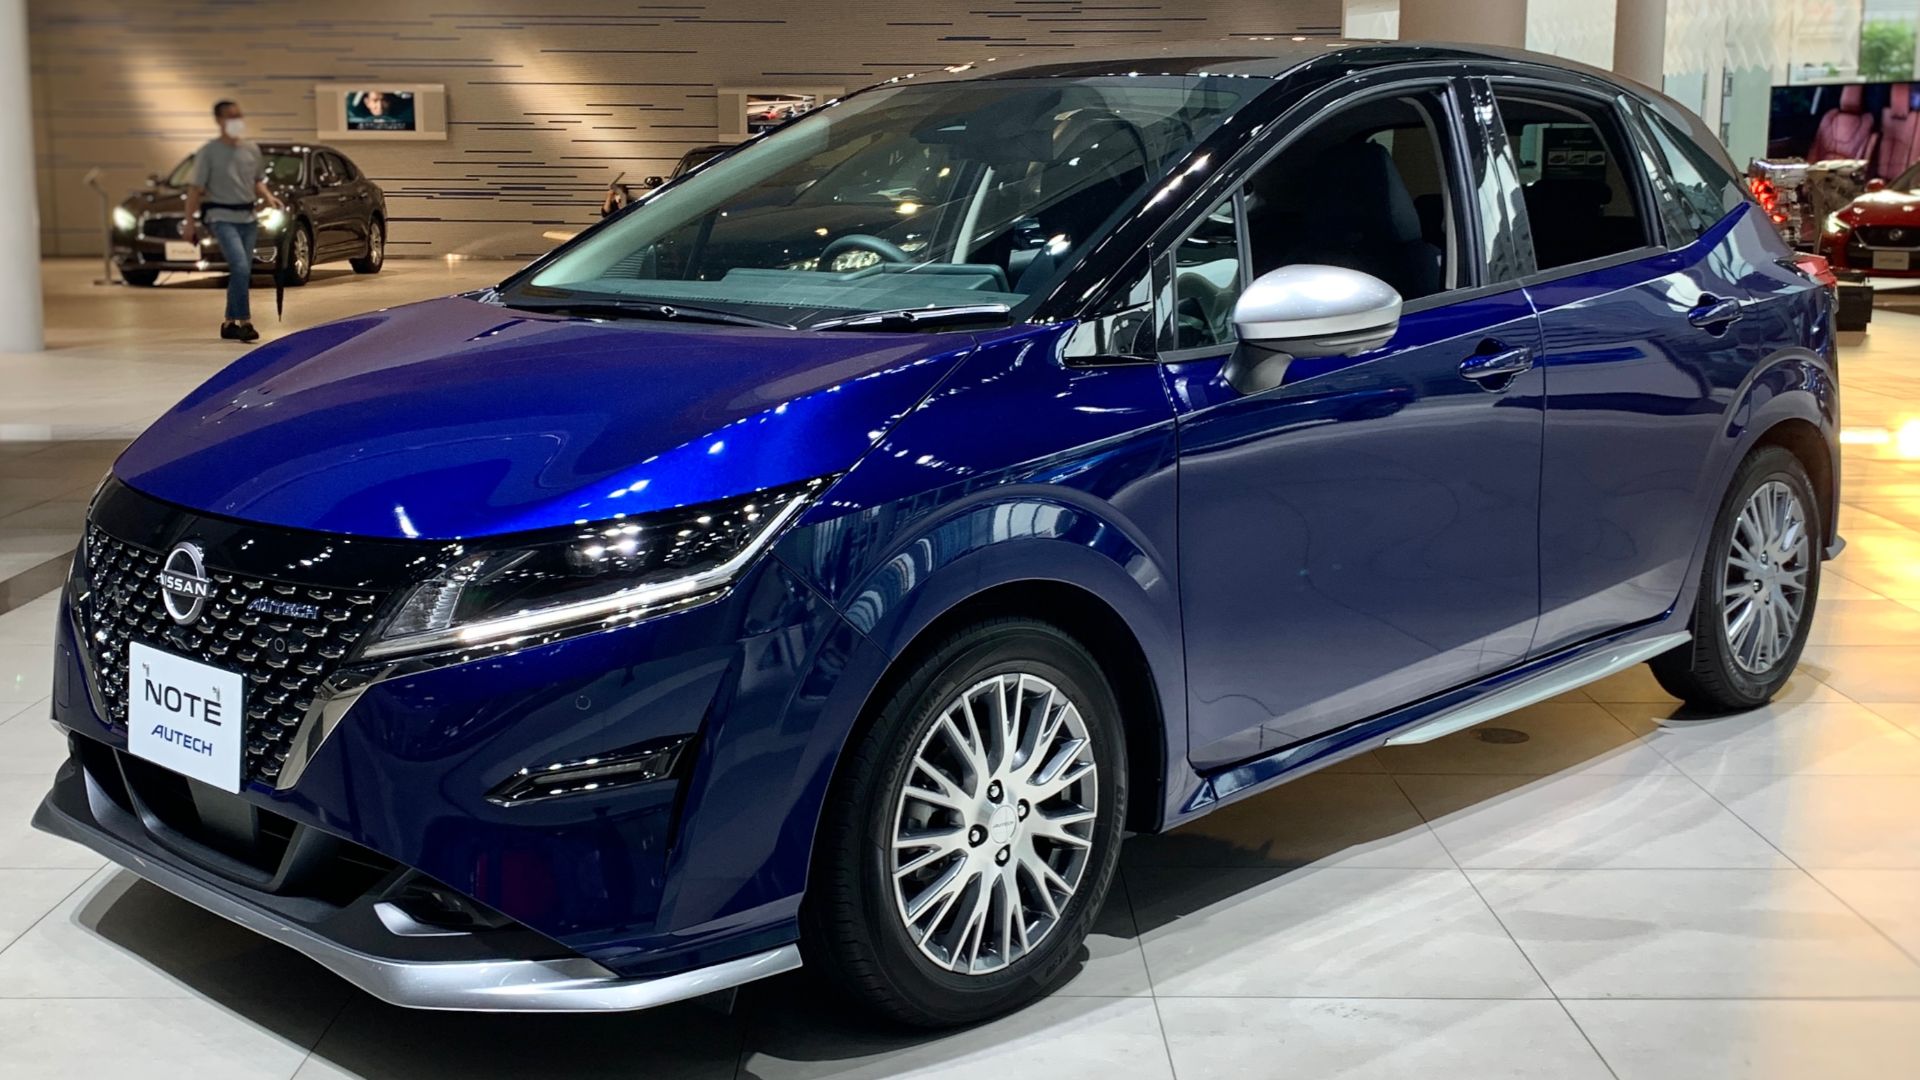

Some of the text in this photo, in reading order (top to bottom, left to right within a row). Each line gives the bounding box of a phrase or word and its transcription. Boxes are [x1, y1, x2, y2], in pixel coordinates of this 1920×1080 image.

[160, 571, 208, 597] NISSAN
[247, 598, 319, 620] AUTECH
[145, 678, 222, 727] NOTE
[151, 724, 213, 757] AUTECH
